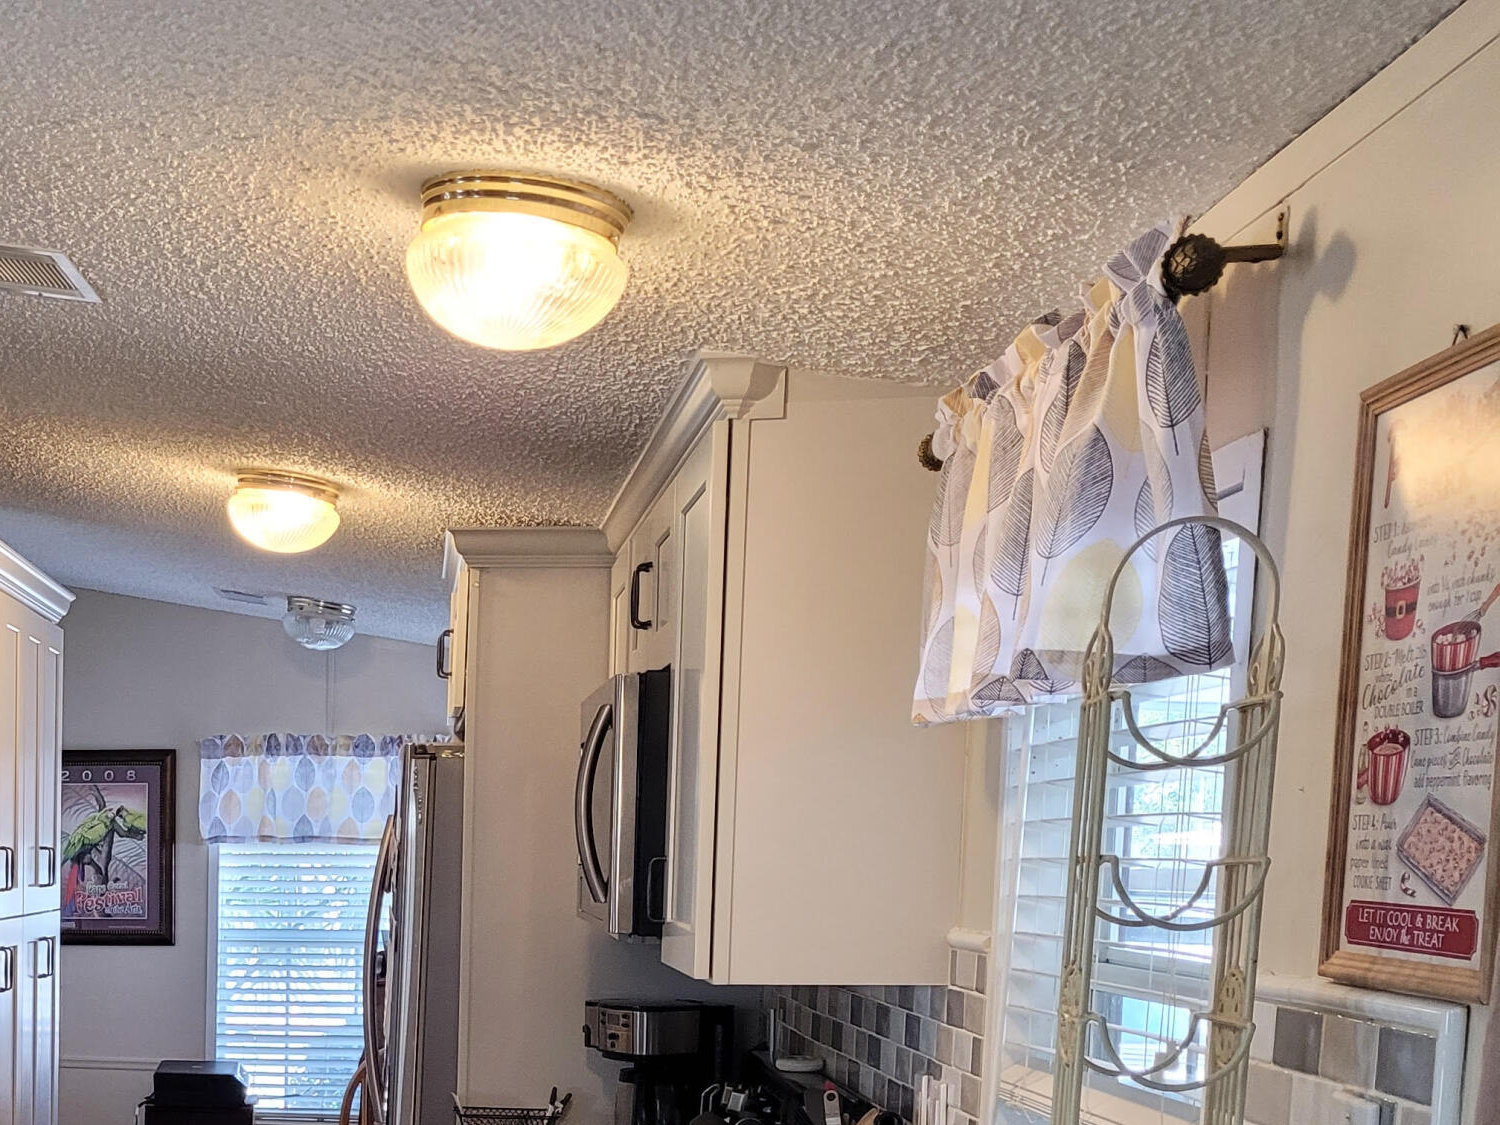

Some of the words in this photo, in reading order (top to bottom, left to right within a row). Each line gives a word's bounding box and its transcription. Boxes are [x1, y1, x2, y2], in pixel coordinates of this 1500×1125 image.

[1362, 662, 1425, 710] Chocolate
[1414, 728, 1434, 746] STEP
[62, 769, 137, 782] 2008
[1352, 814, 1371, 831] STEP
[74, 886, 144, 915] Festival
[1358, 907, 1376, 923] LET
[1376, 909, 1386, 924] IT
[1386, 910, 1413, 927] COOL
[1415, 913, 1423, 928] &
[1425, 914, 1460, 933] BREAK
[1369, 925, 1399, 942] ENJOY
[1399, 925, 1411, 945] the
[1412, 930, 1445, 948] TREAT
